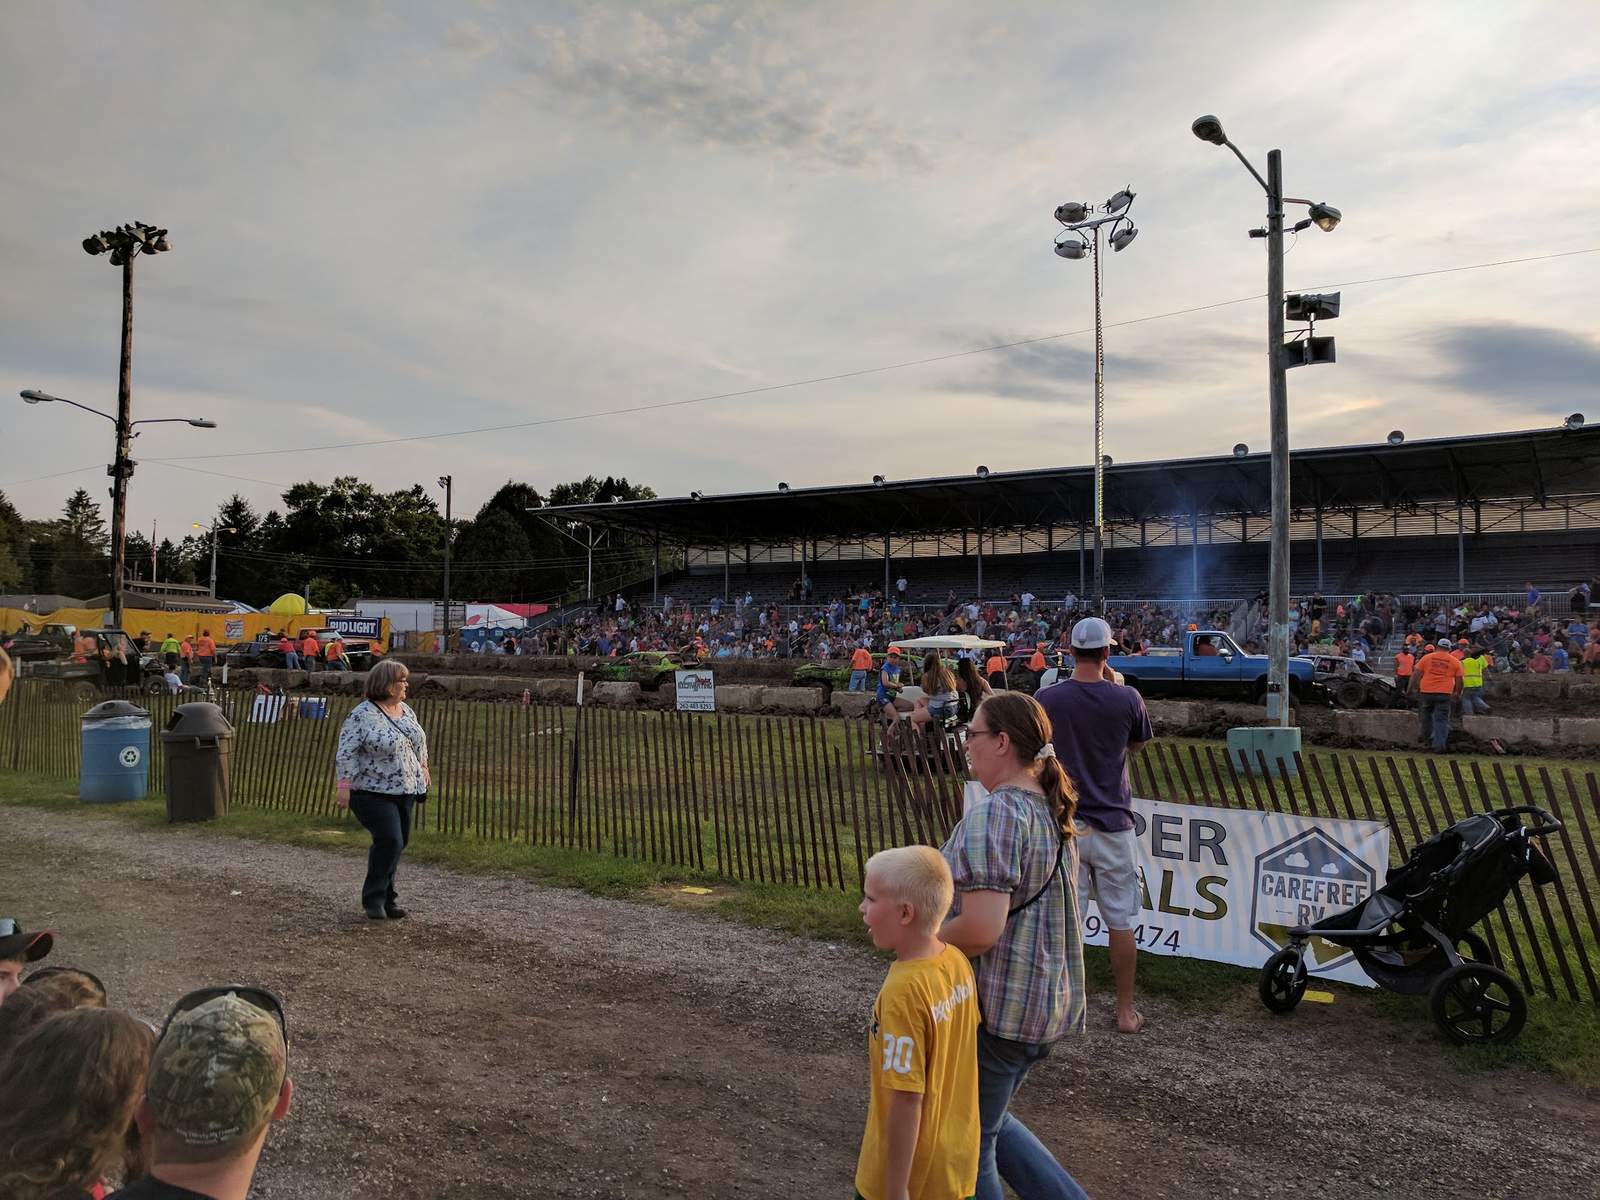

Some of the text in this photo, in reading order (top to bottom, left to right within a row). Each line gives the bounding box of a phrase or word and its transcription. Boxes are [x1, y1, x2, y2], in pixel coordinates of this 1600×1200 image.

[330, 621, 376, 634] BUD LIGHT
[1261, 873, 1368, 906] CAREFREE
[1297, 903, 1326, 927] RV
